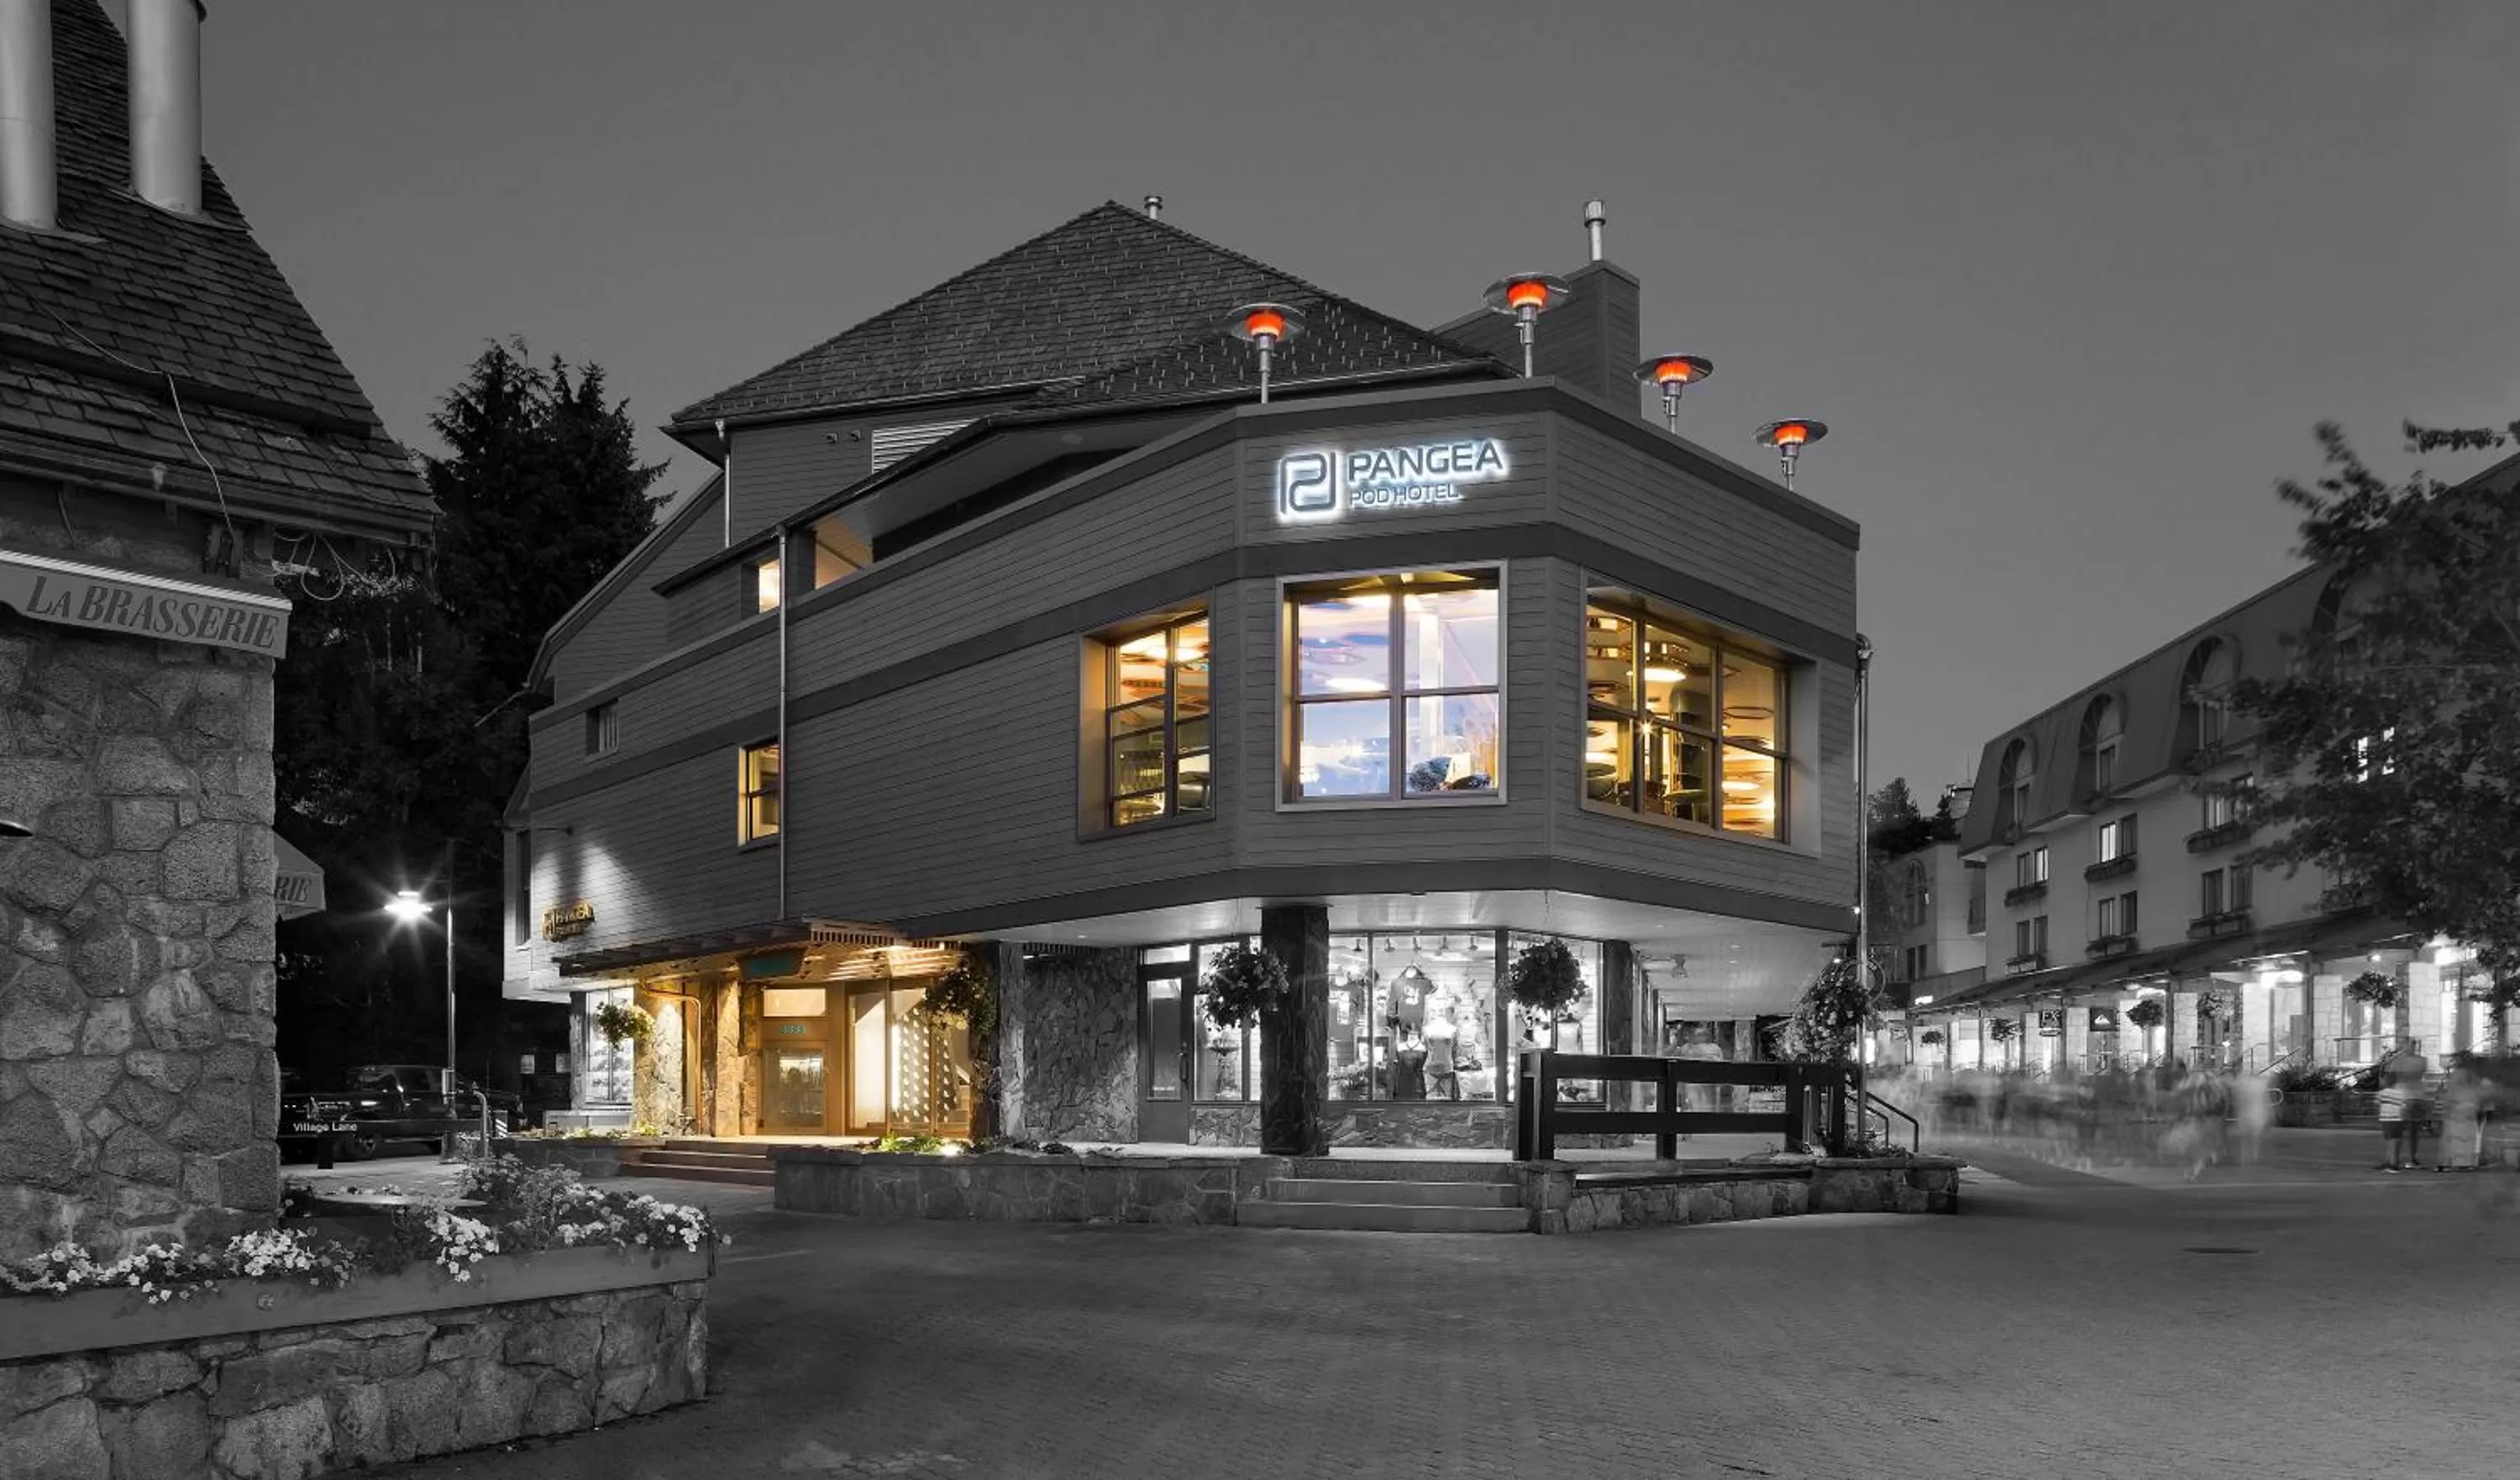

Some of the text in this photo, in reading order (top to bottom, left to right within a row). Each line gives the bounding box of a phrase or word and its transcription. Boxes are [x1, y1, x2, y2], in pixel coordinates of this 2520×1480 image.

[1347, 439, 1504, 482] PANGEA
[1351, 482, 1460, 506] POD HOTEL
[26, 575, 280, 649] LA BRASSERIE
[292, 1121, 357, 1133] Village Lane
